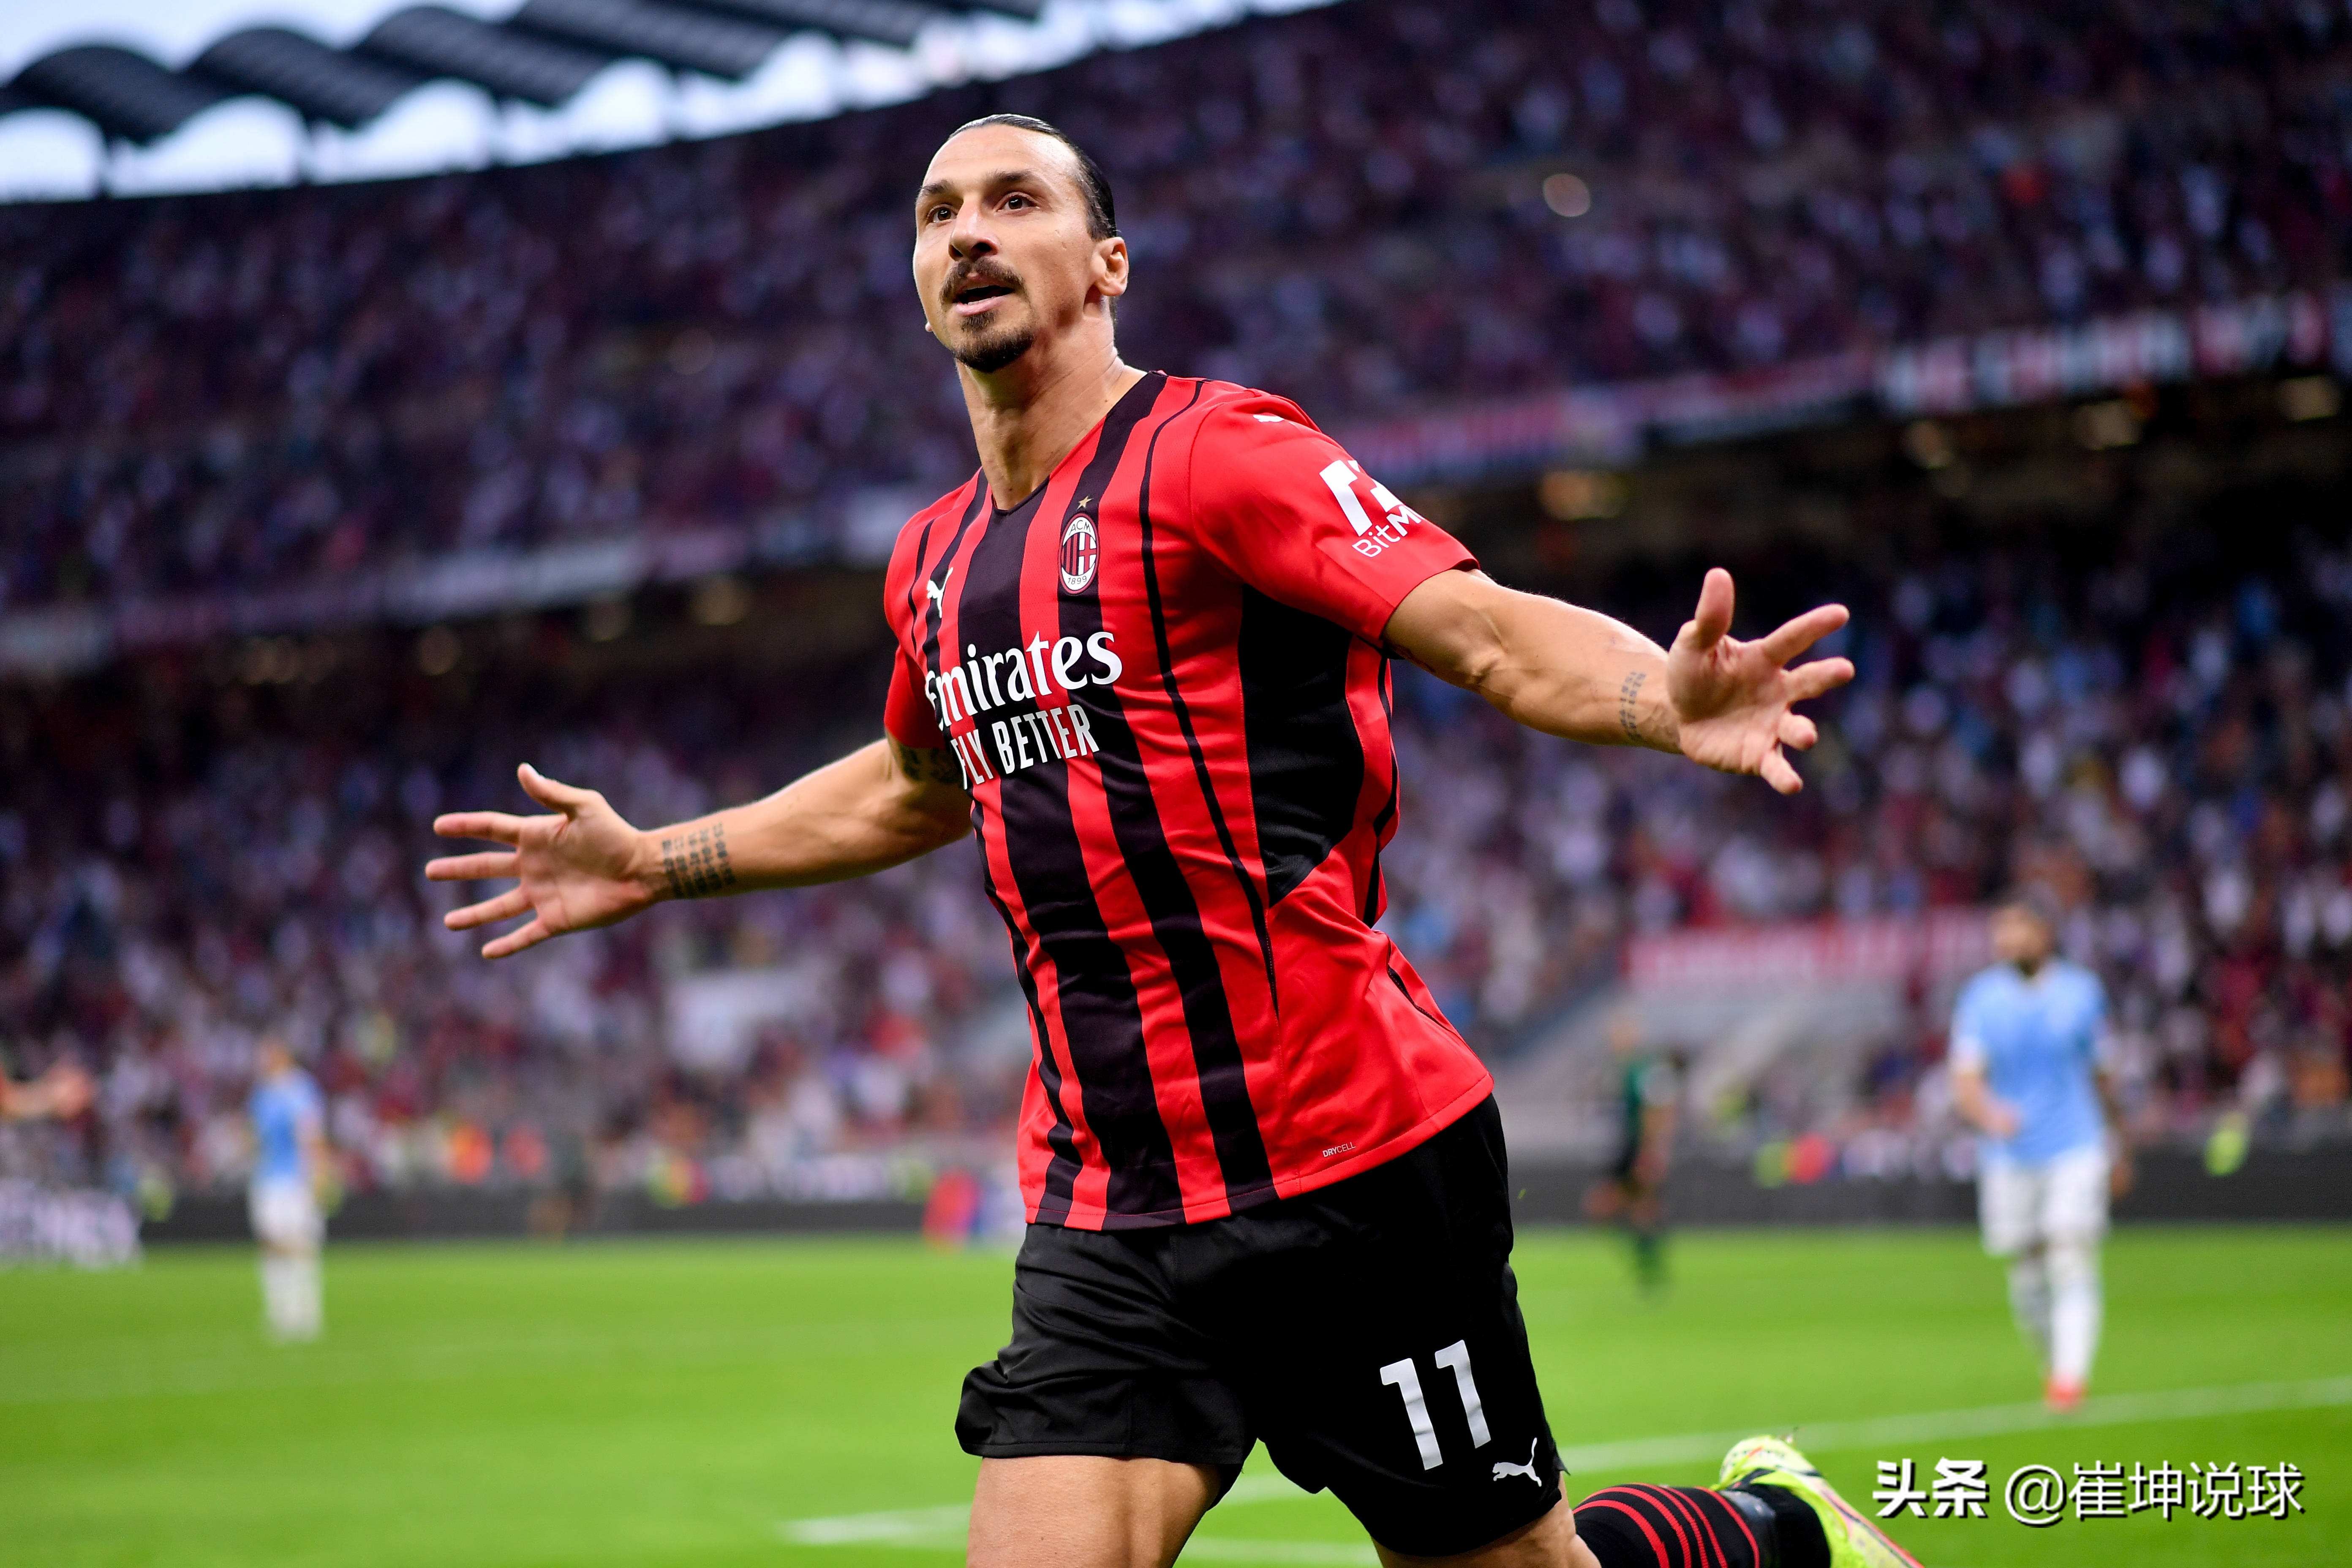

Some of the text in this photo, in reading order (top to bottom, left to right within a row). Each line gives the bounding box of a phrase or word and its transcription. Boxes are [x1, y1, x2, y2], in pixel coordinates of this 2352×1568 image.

[1068, 520, 1091, 536] ACM
[1352, 505, 1424, 558] BitM
[1067, 575, 1087, 585] 1899
[925, 631, 1122, 731] Emirates
[950, 704, 1100, 790] FLY BETTER
[1322, 1141, 1356, 1157] DRYCELL
[1380, 1339, 1491, 1470] 11
